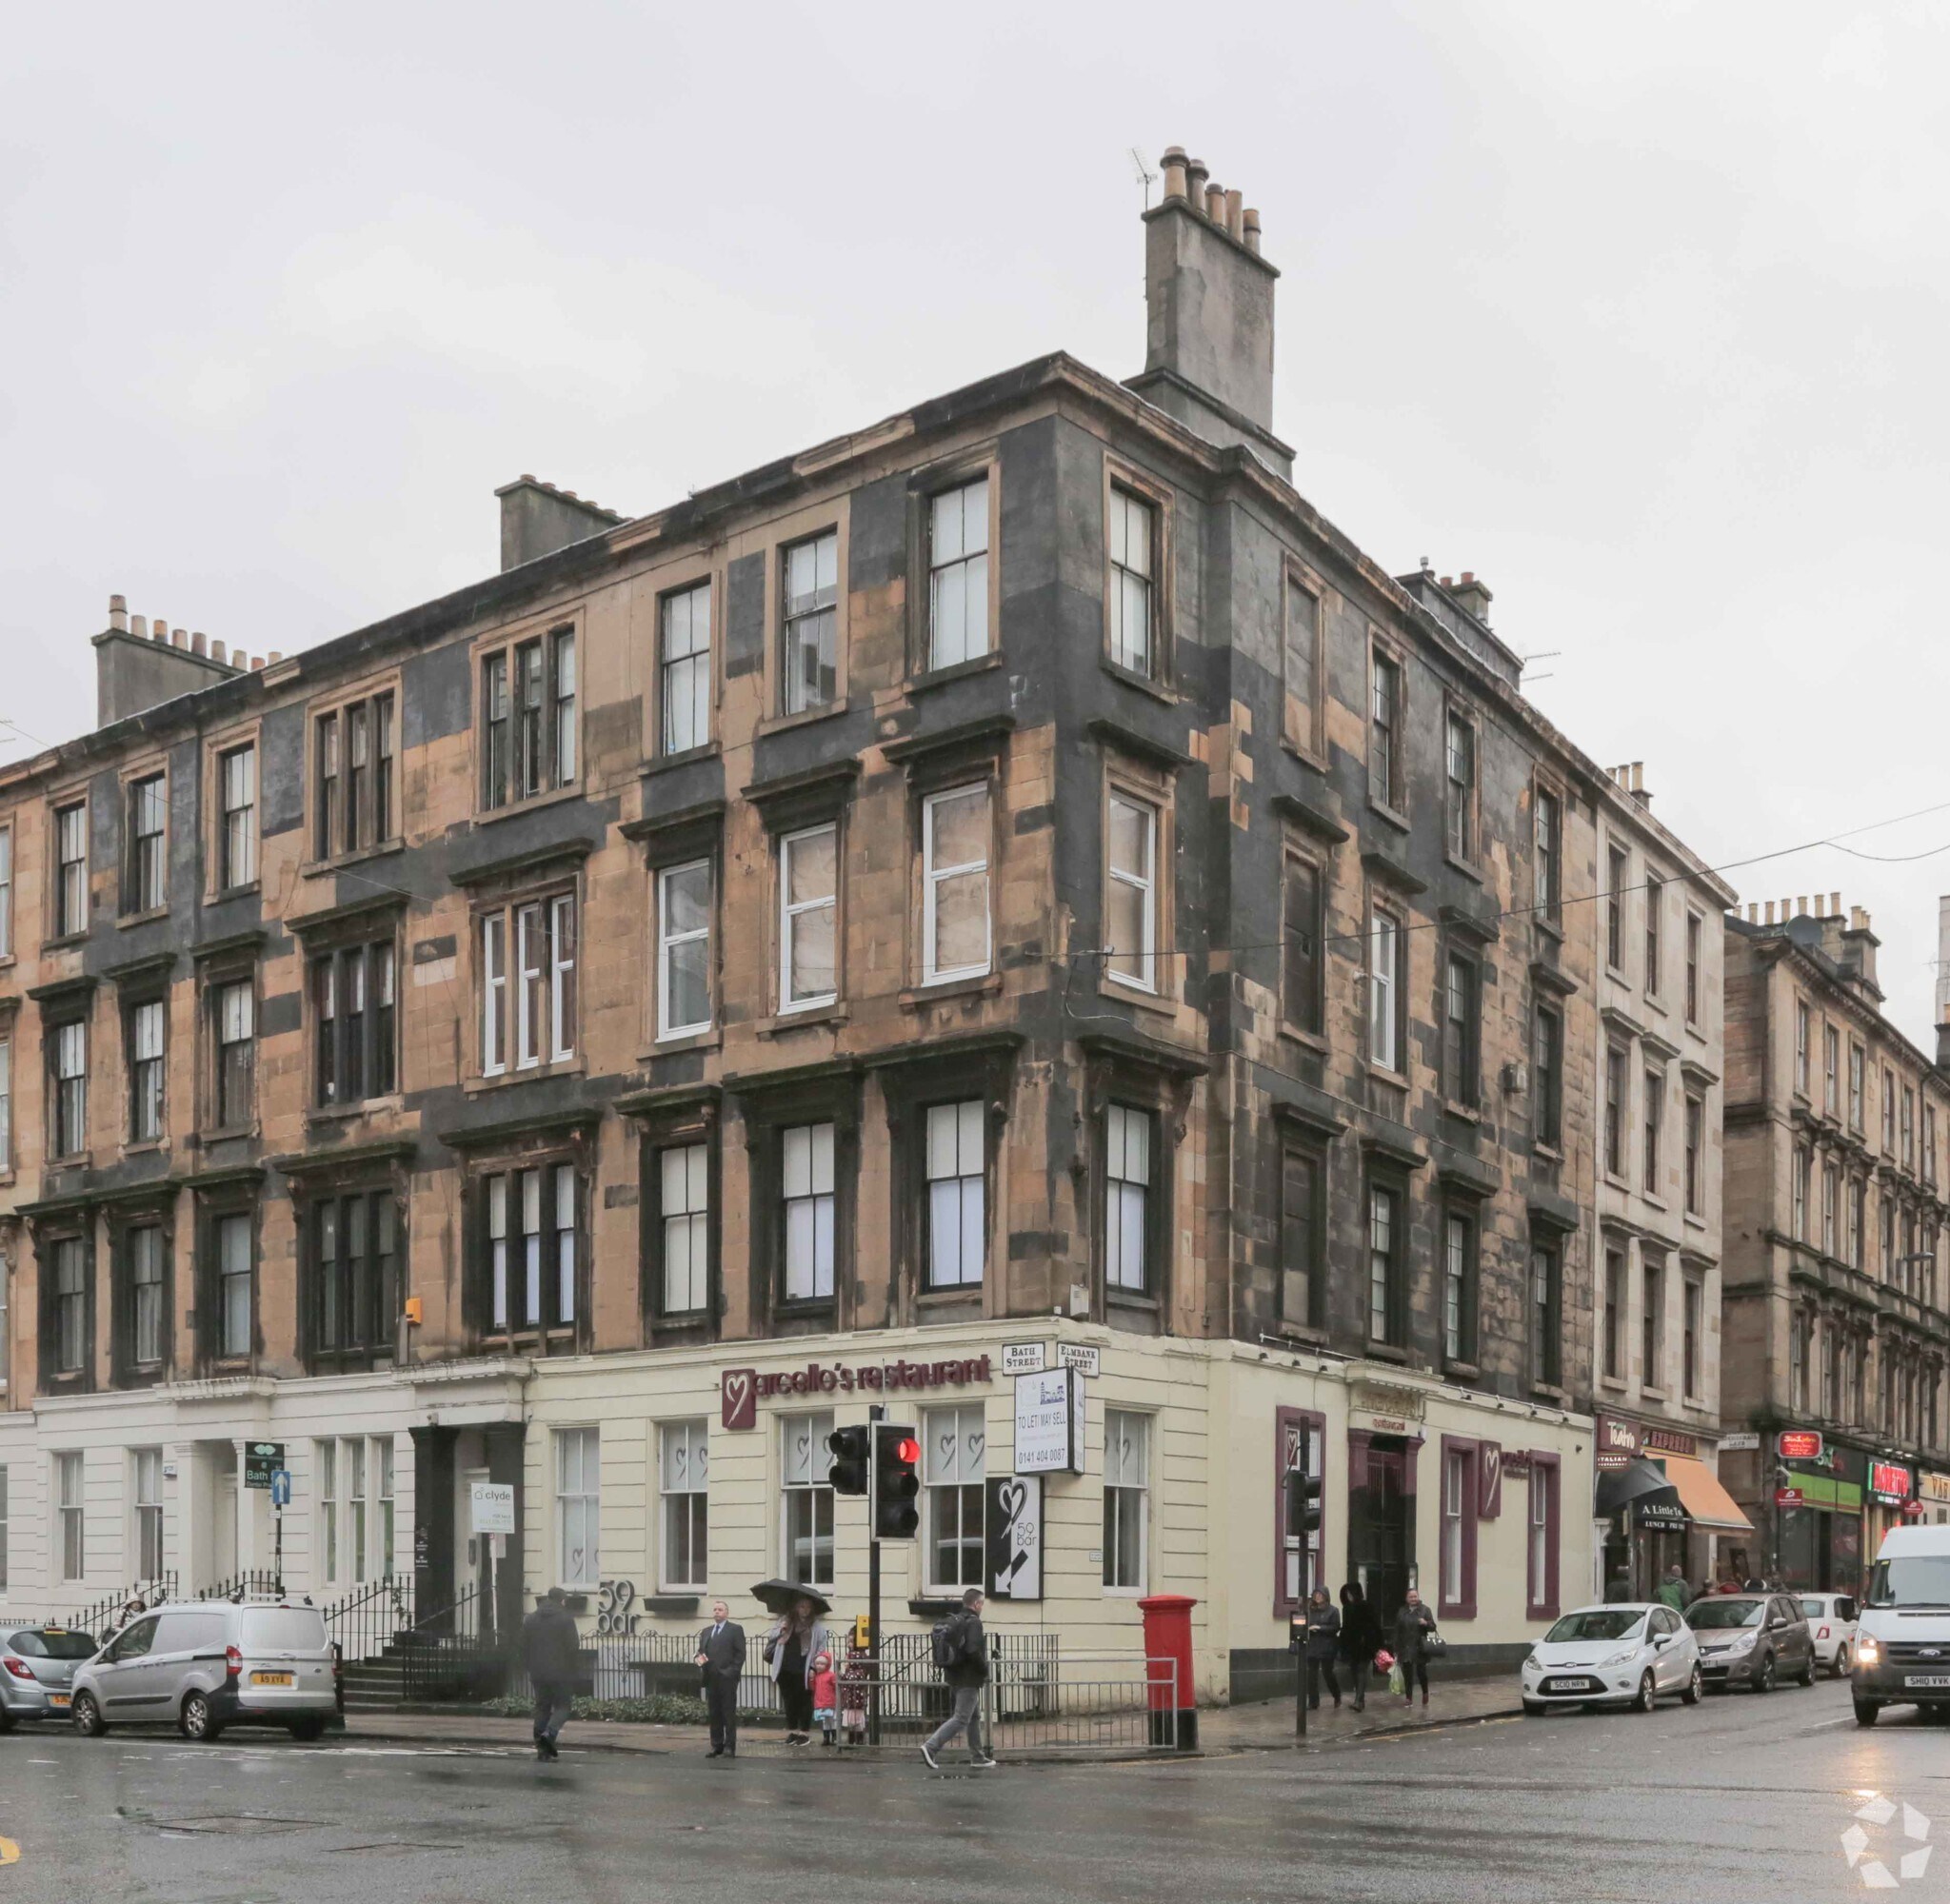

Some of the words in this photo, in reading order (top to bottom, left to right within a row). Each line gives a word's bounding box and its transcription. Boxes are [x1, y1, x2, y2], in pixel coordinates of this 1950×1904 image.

[1011, 1347, 1035, 1357] BATH
[1061, 1345, 1096, 1359] ELMBANK
[1006, 1357, 1042, 1367] STREET
[1065, 1356, 1093, 1370] STREET
[857, 1354, 992, 1390] restaurant
[1018, 1416, 1026, 1429] TO
[1053, 1412, 1066, 1425] SELL
[1607, 1421, 1635, 1449] Teatro
[1018, 1452, 1034, 1464] 0141
[1036, 1450, 1048, 1462] 404
[247, 1470, 269, 1480] Bath
[486, 1490, 511, 1501] clyde
[1642, 1505, 1650, 1515] A
[1652, 1505, 1674, 1516] Little
[1017, 1522, 1035, 1537] 59
[1016, 1535, 1037, 1546] bar
[599, 1579, 635, 1612] 59
